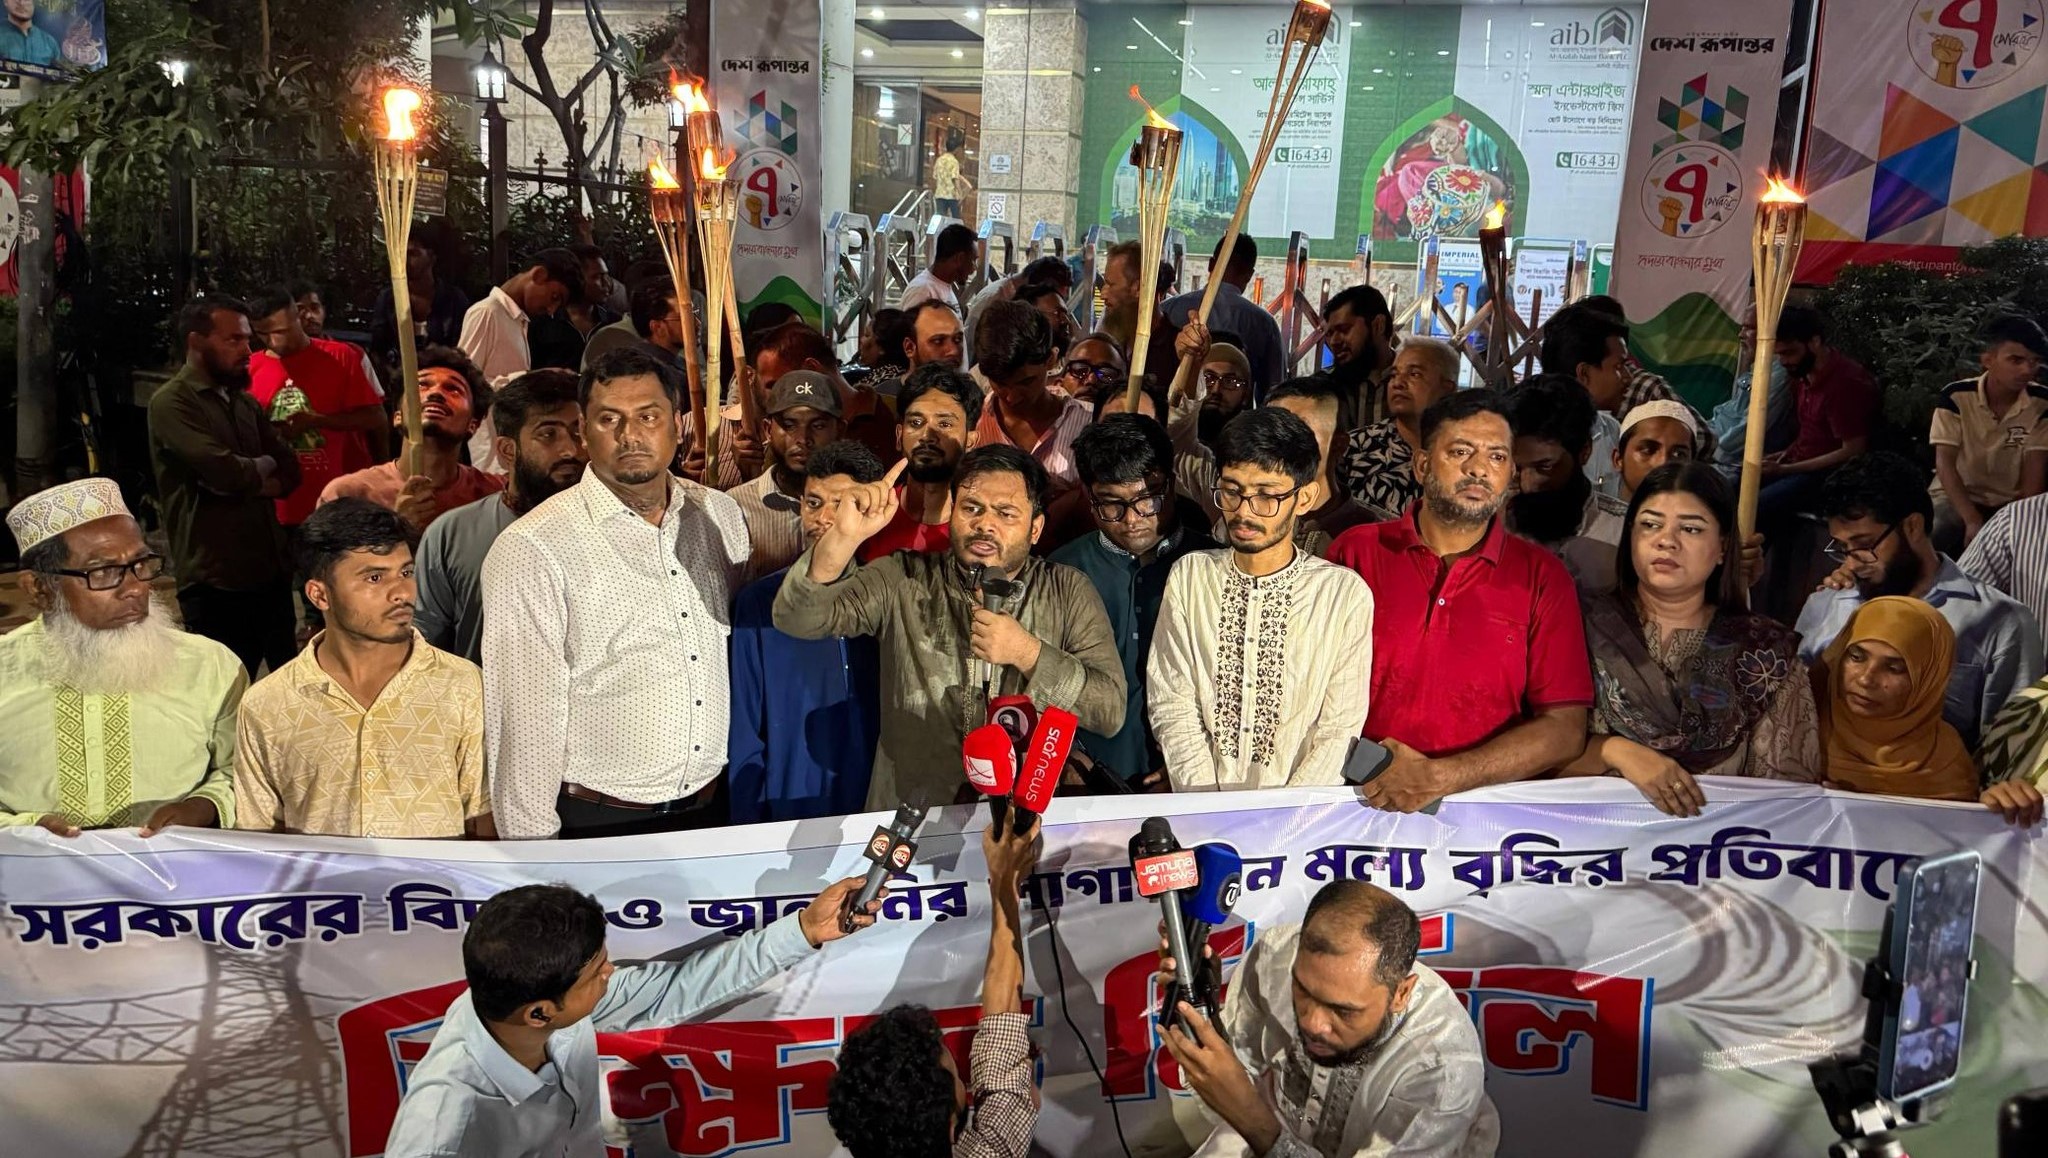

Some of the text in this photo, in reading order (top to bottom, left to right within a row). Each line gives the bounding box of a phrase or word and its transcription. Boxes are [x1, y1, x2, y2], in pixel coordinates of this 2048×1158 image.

[1550, 21, 1590, 45] aib
[1650, 37, 1775, 53] দেশ রূপান্তর
[721, 59, 810, 74] দেশ রূপান্তর
[1556, 81, 1626, 99] এন্টারপ্রাইজ
[1291, 150, 1328, 161] 16434
[1574, 155, 1615, 167] 16434
[746, 166, 779, 217] ৭
[1664, 163, 1709, 223] ৭
[794, 381, 814, 395] ck
[10, 892, 364, 950] সরকারের
